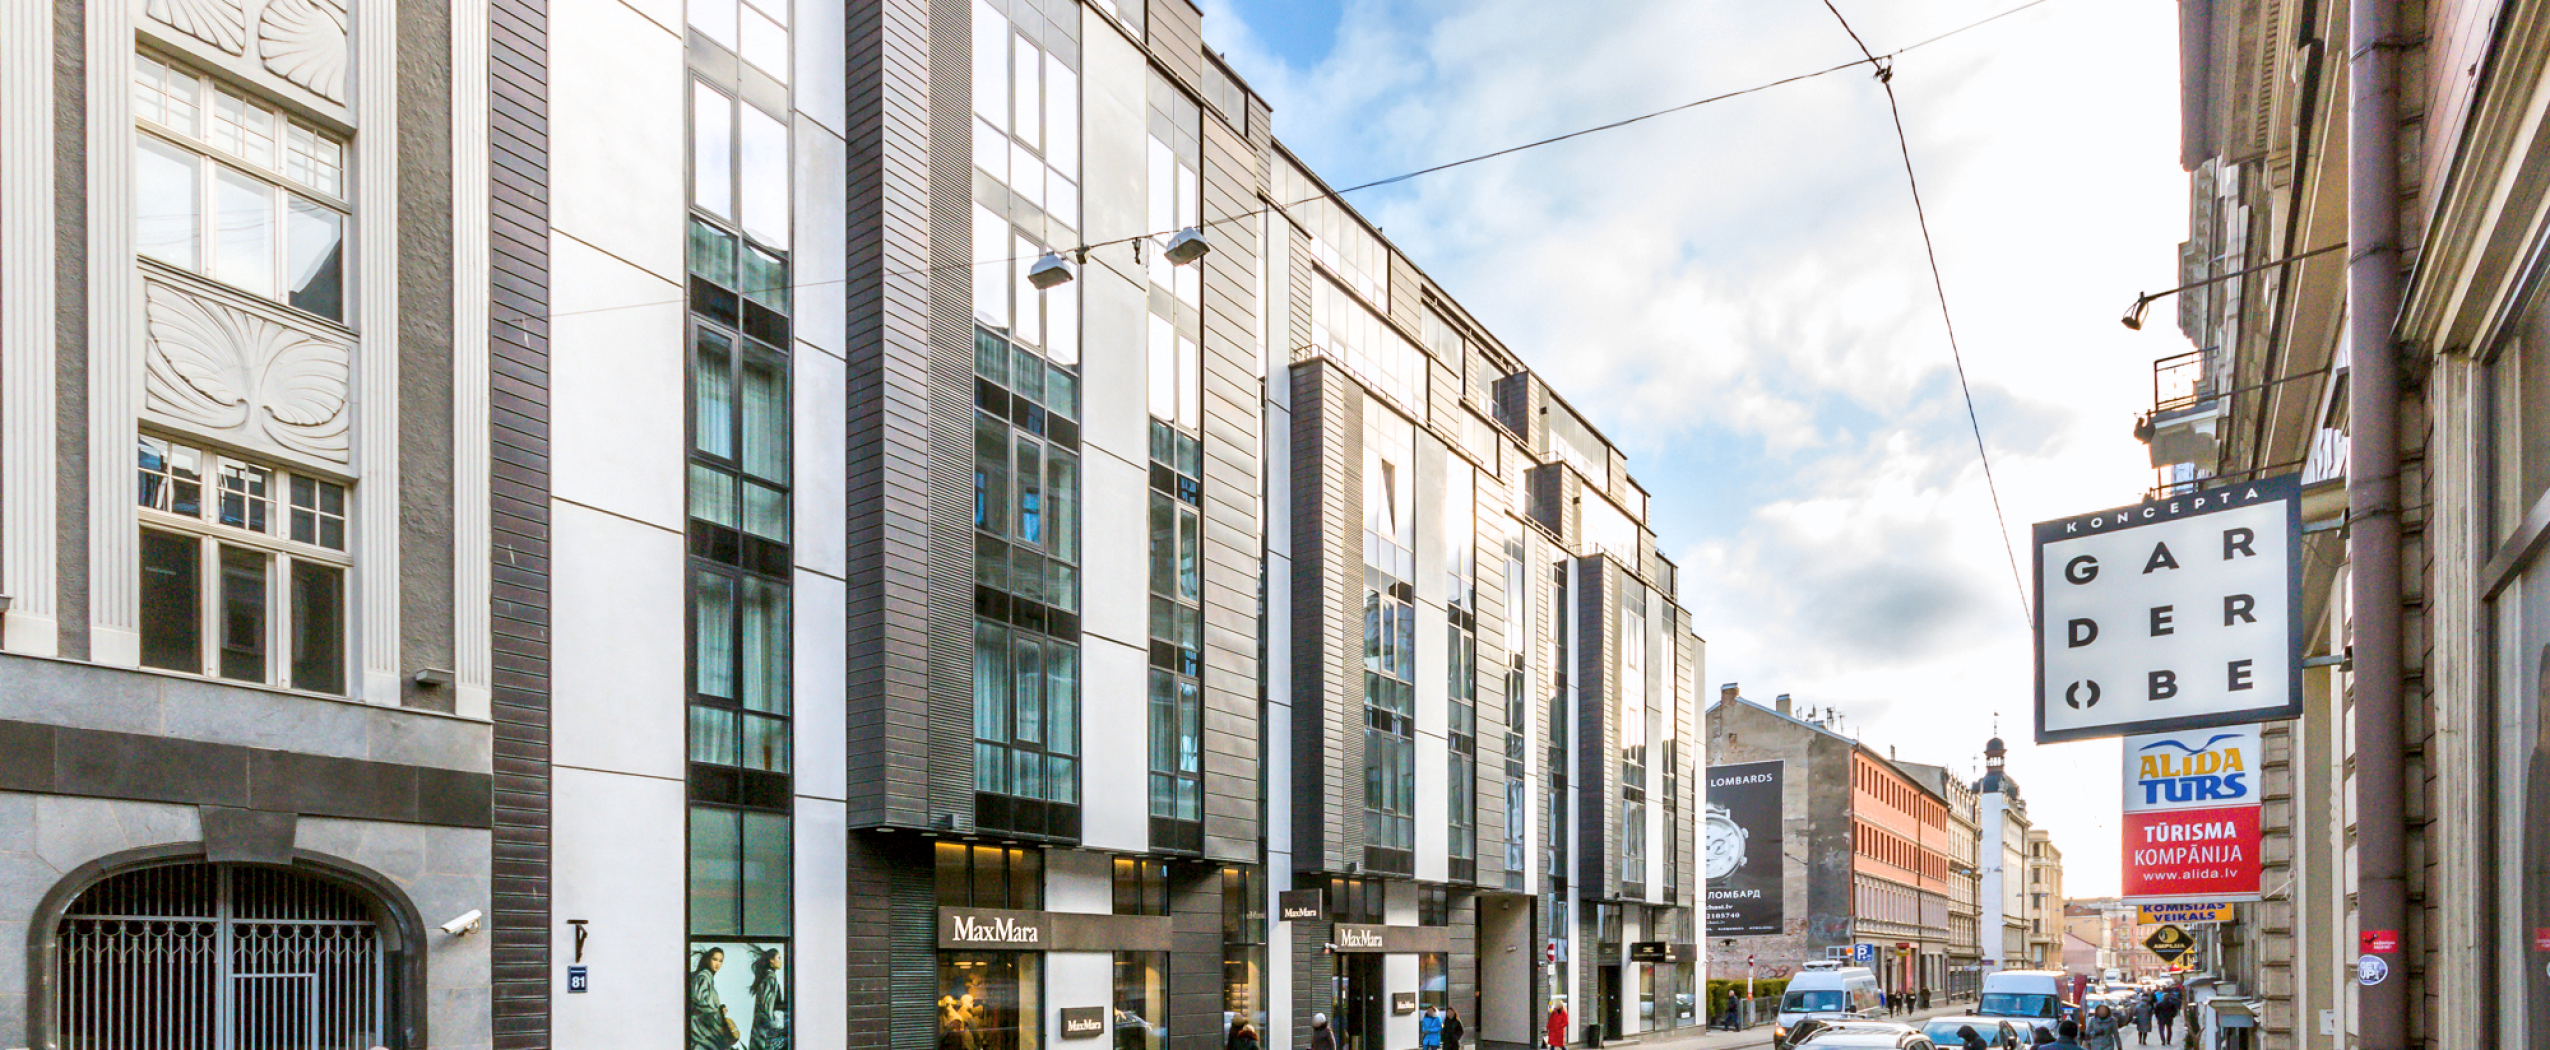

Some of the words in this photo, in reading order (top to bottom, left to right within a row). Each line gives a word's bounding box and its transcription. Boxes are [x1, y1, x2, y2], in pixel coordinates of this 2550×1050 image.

[2066, 487, 2259, 534] KONCEPTA
[2139, 747, 2245, 780] ALIDA
[1710, 773, 1773, 787] LOMBARDS
[2138, 772, 2248, 804] TURS
[2144, 821, 2237, 843] TŪRISMA
[2134, 844, 2243, 866] KOMPĀNIJA
[2143, 868, 2238, 881] www.alida.lv
[1707, 889, 1762, 900] ЛОМБАРД
[1284, 906, 1317, 918] MaxMara
[2142, 902, 2226, 913] KOMISIJAS
[2153, 911, 2216, 922] VEIKALS
[952, 915, 1038, 942] MaxMara
[1341, 928, 1383, 947] MaxMara
[572, 976, 585, 988] 81
